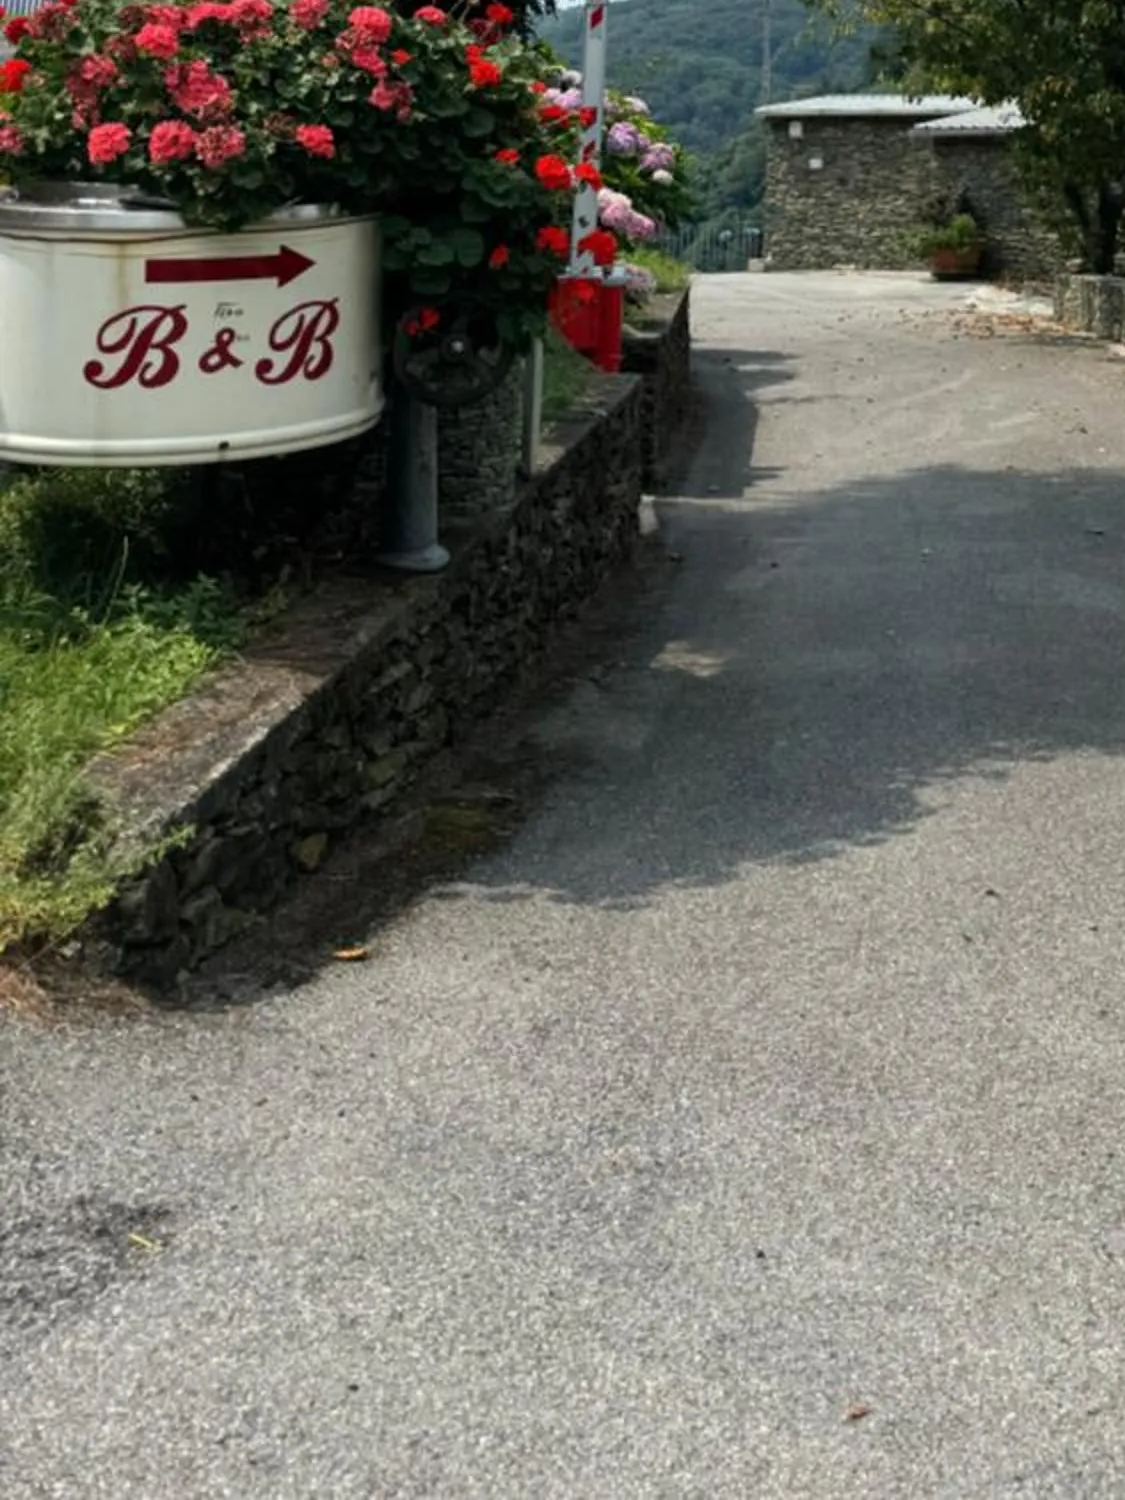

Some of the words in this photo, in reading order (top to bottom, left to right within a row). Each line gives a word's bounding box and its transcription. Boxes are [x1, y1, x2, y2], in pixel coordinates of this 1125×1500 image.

[83, 304, 189, 389] B
[198, 327, 244, 374] &
[254, 297, 340, 386] B
